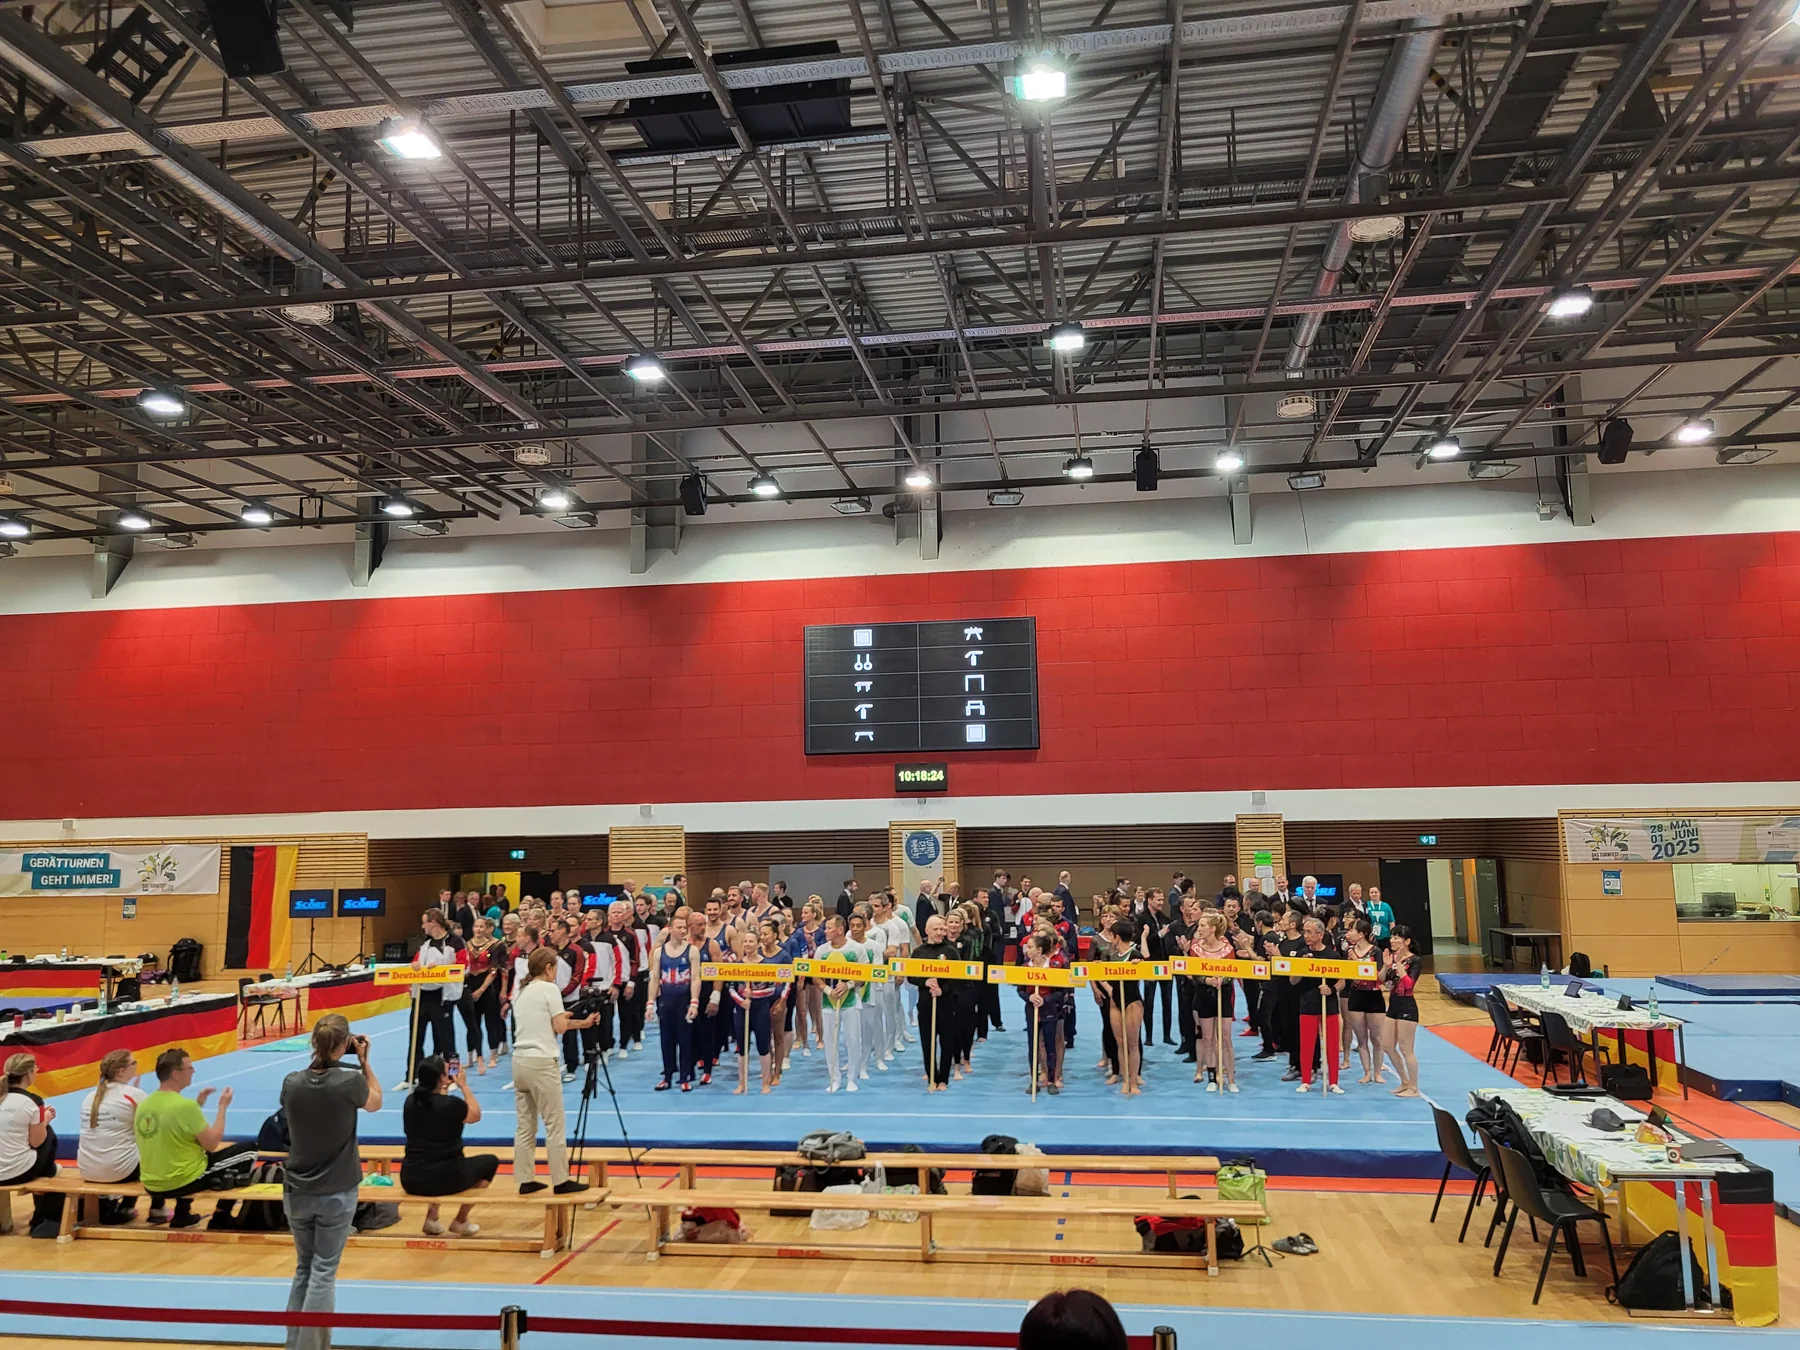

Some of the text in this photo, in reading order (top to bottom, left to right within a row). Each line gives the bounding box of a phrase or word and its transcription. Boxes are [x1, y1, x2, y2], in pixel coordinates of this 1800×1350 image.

[898, 770, 944, 782] 10:18:24
[1650, 819, 1692, 834] 28. MAI
[1650, 827, 1699, 844] 01. JUNI
[1651, 837, 1700, 861] 2025
[29, 856, 104, 868] GERÄTTURNEN
[40, 874, 114, 885] GEHT IMMER!
[718, 967, 776, 978] Großbritannien
[820, 965, 862, 976] Brasilien
[921, 964, 950, 973] Irland
[1104, 966, 1137, 976] Italien
[1201, 962, 1238, 973] Kanada
[1308, 963, 1340, 974] Japan
[392, 969, 447, 980] Deutschland
[1027, 971, 1047, 981] USA
[1049, 1255, 1097, 1265] BENZ
